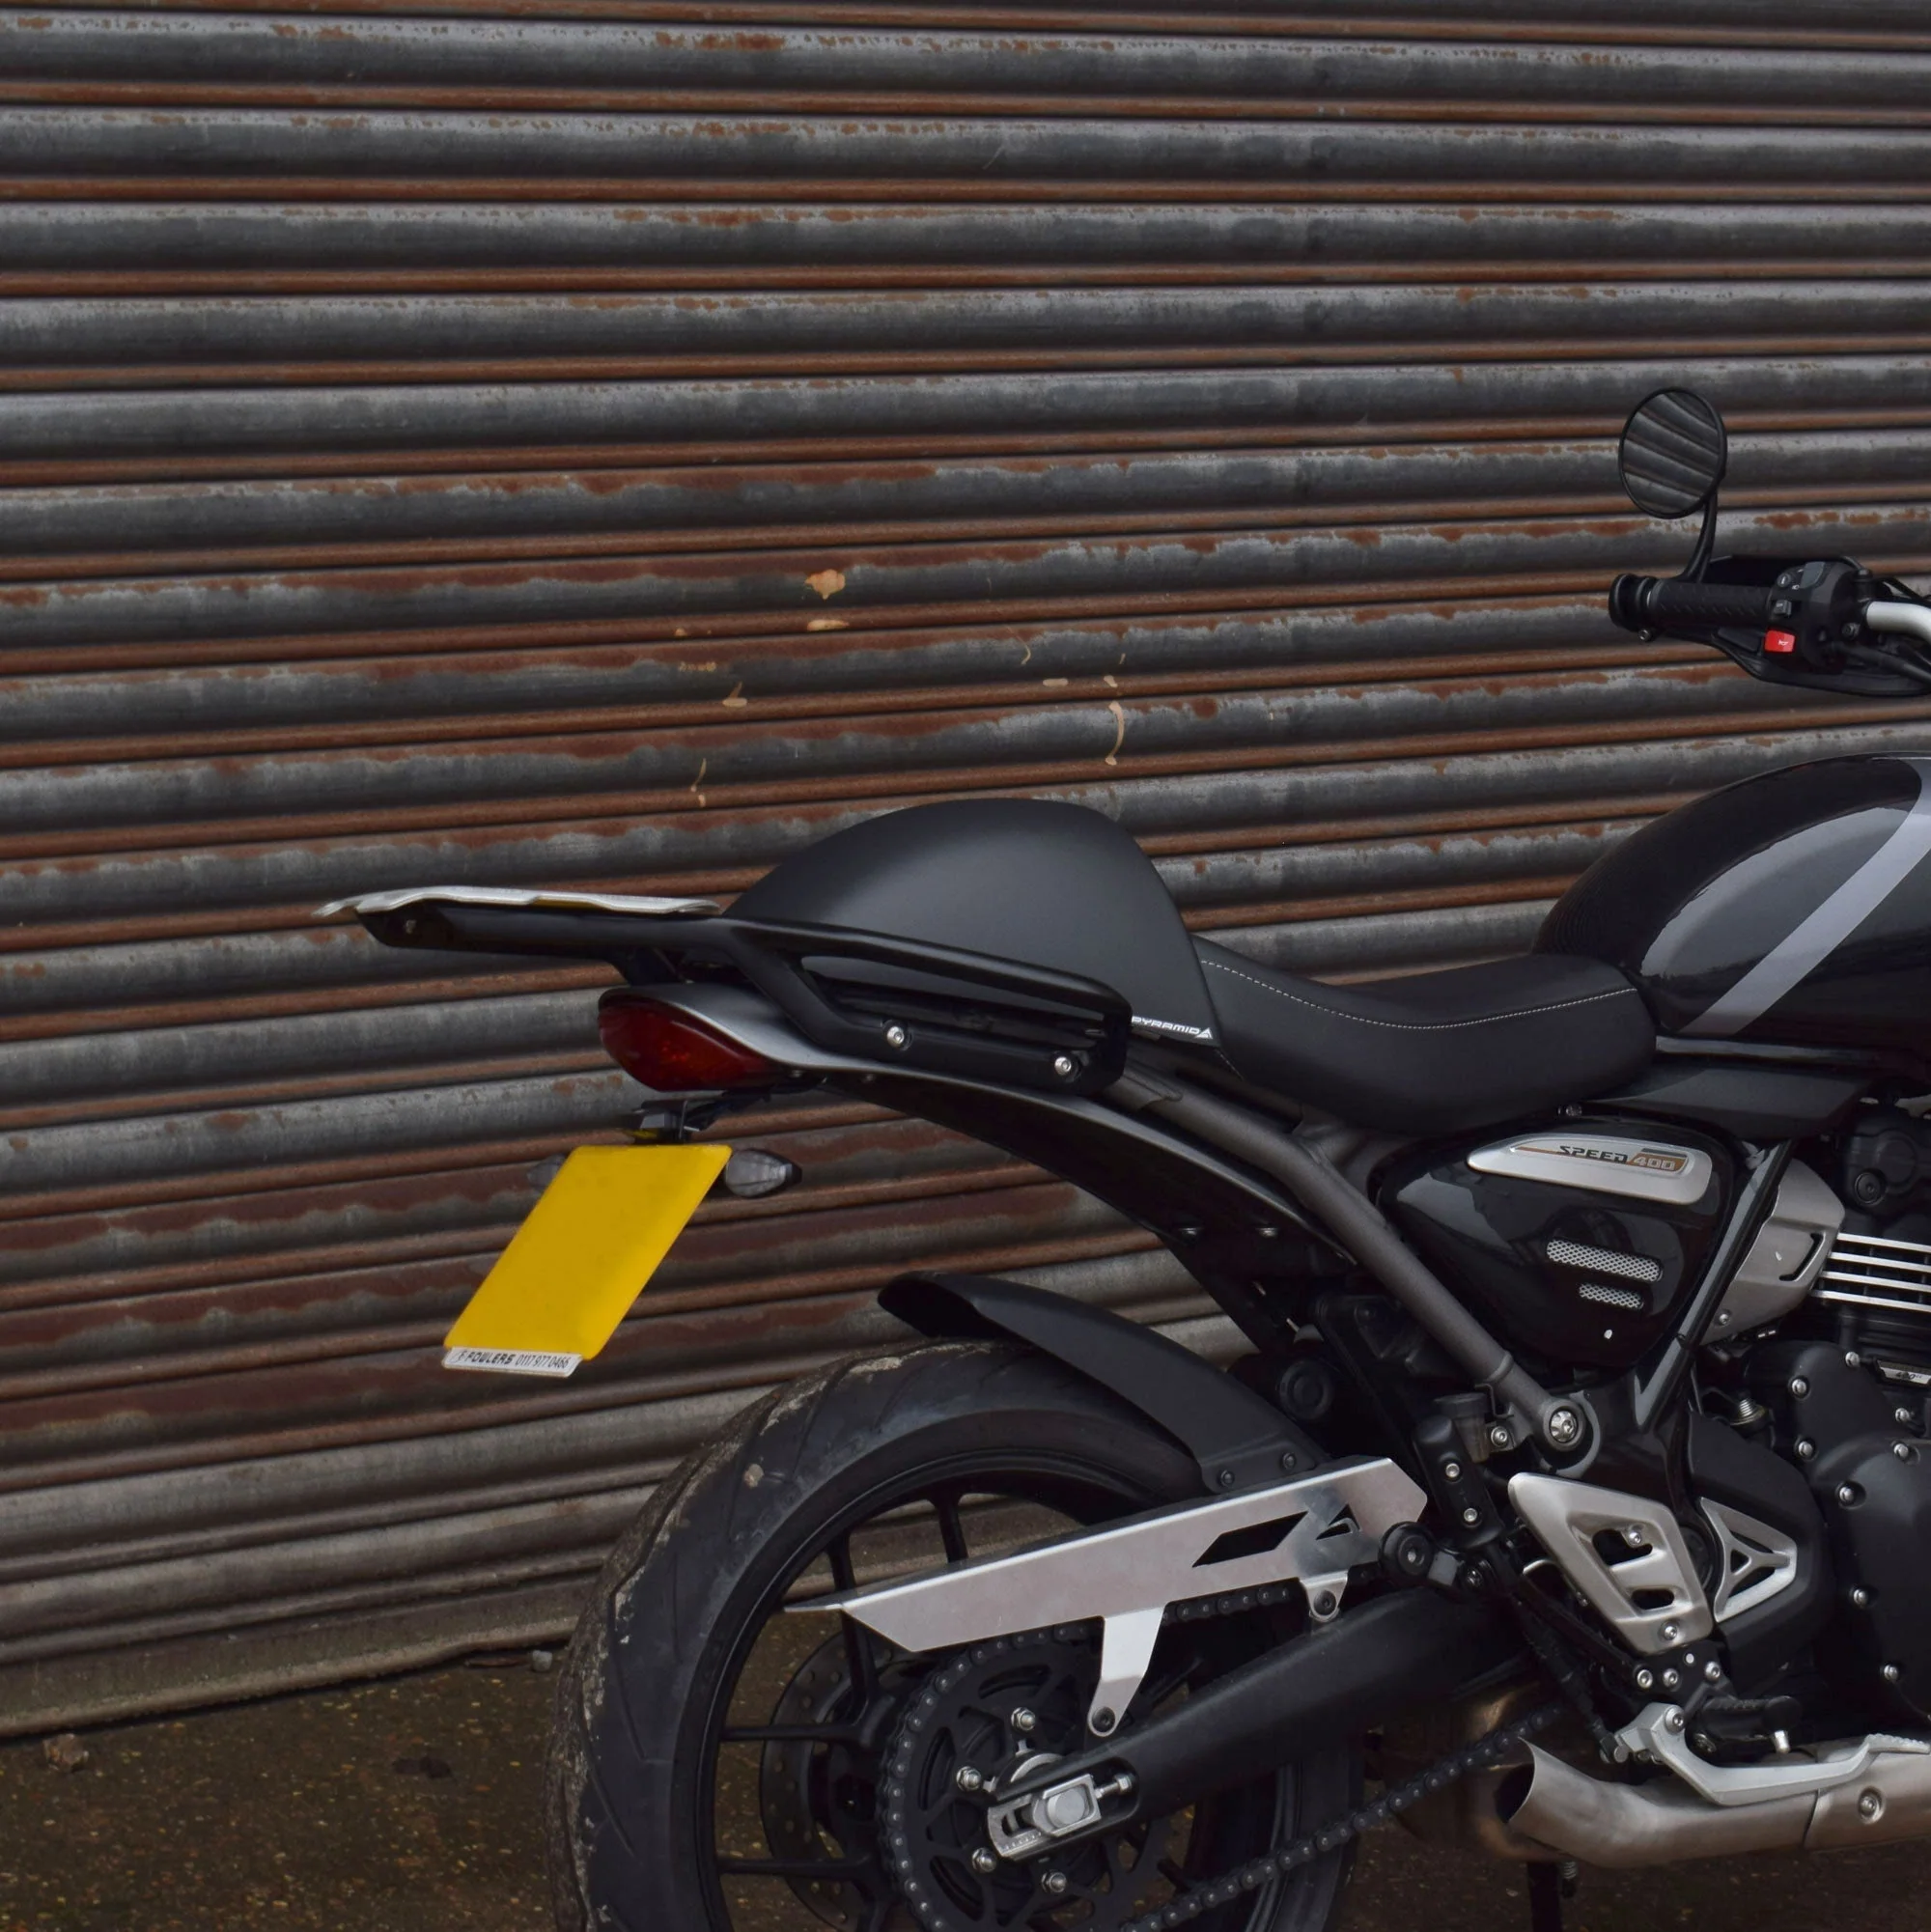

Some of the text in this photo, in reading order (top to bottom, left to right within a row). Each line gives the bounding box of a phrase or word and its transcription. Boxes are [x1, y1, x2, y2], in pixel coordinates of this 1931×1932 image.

[1131, 1016, 1201, 1035] PYRAMID
[1559, 1145, 1675, 1171] SPEED 400
[463, 1352, 516, 1364] FOWLERS
